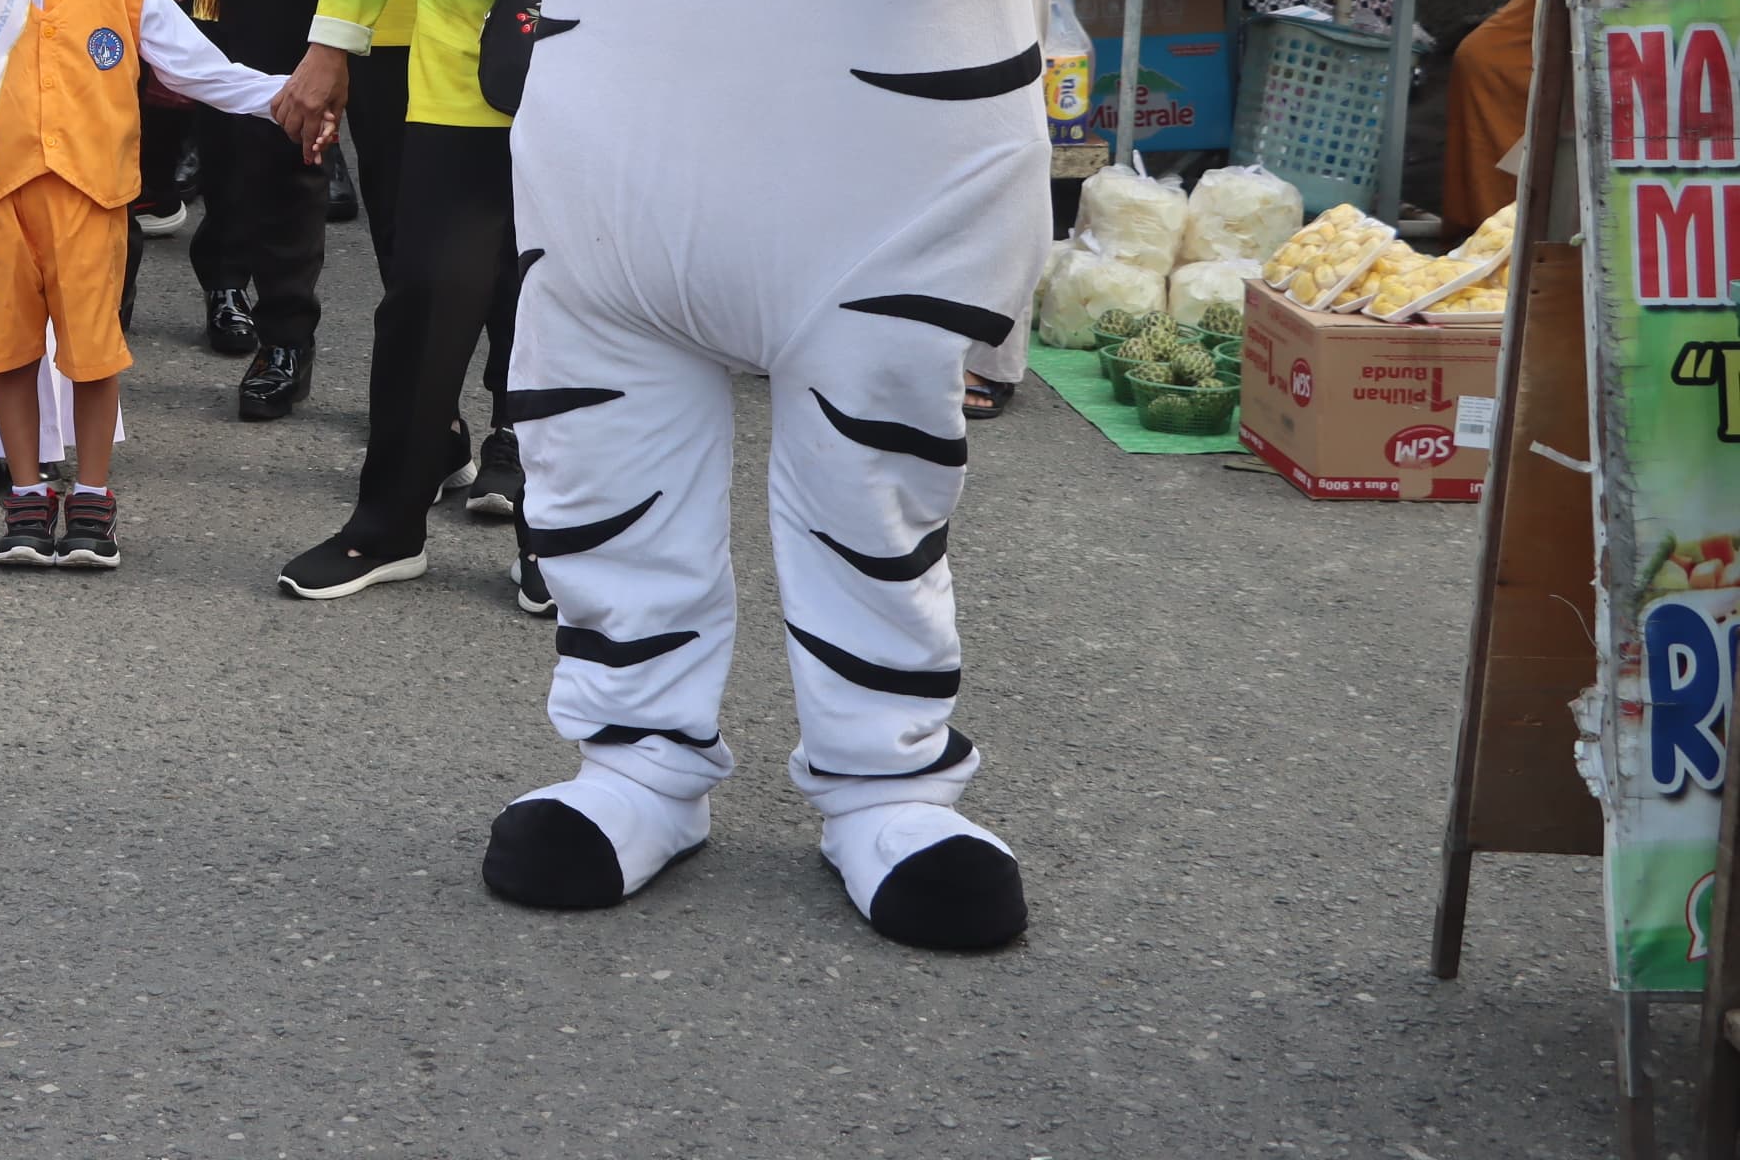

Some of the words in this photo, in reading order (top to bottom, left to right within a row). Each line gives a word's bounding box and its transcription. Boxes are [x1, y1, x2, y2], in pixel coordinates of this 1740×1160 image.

[1606, 29, 1736, 161] NA
[1089, 102, 1194, 128] Mierale
[1362, 365, 1427, 381] Bunda
[1353, 386, 1427, 405] Pilihan
[1431, 367, 1453, 413] 1
[1395, 436, 1450, 463] SGM
[1318, 479, 1350, 491] 900g
[1364, 480, 1388, 492] dus
[1647, 603, 1740, 791] R
